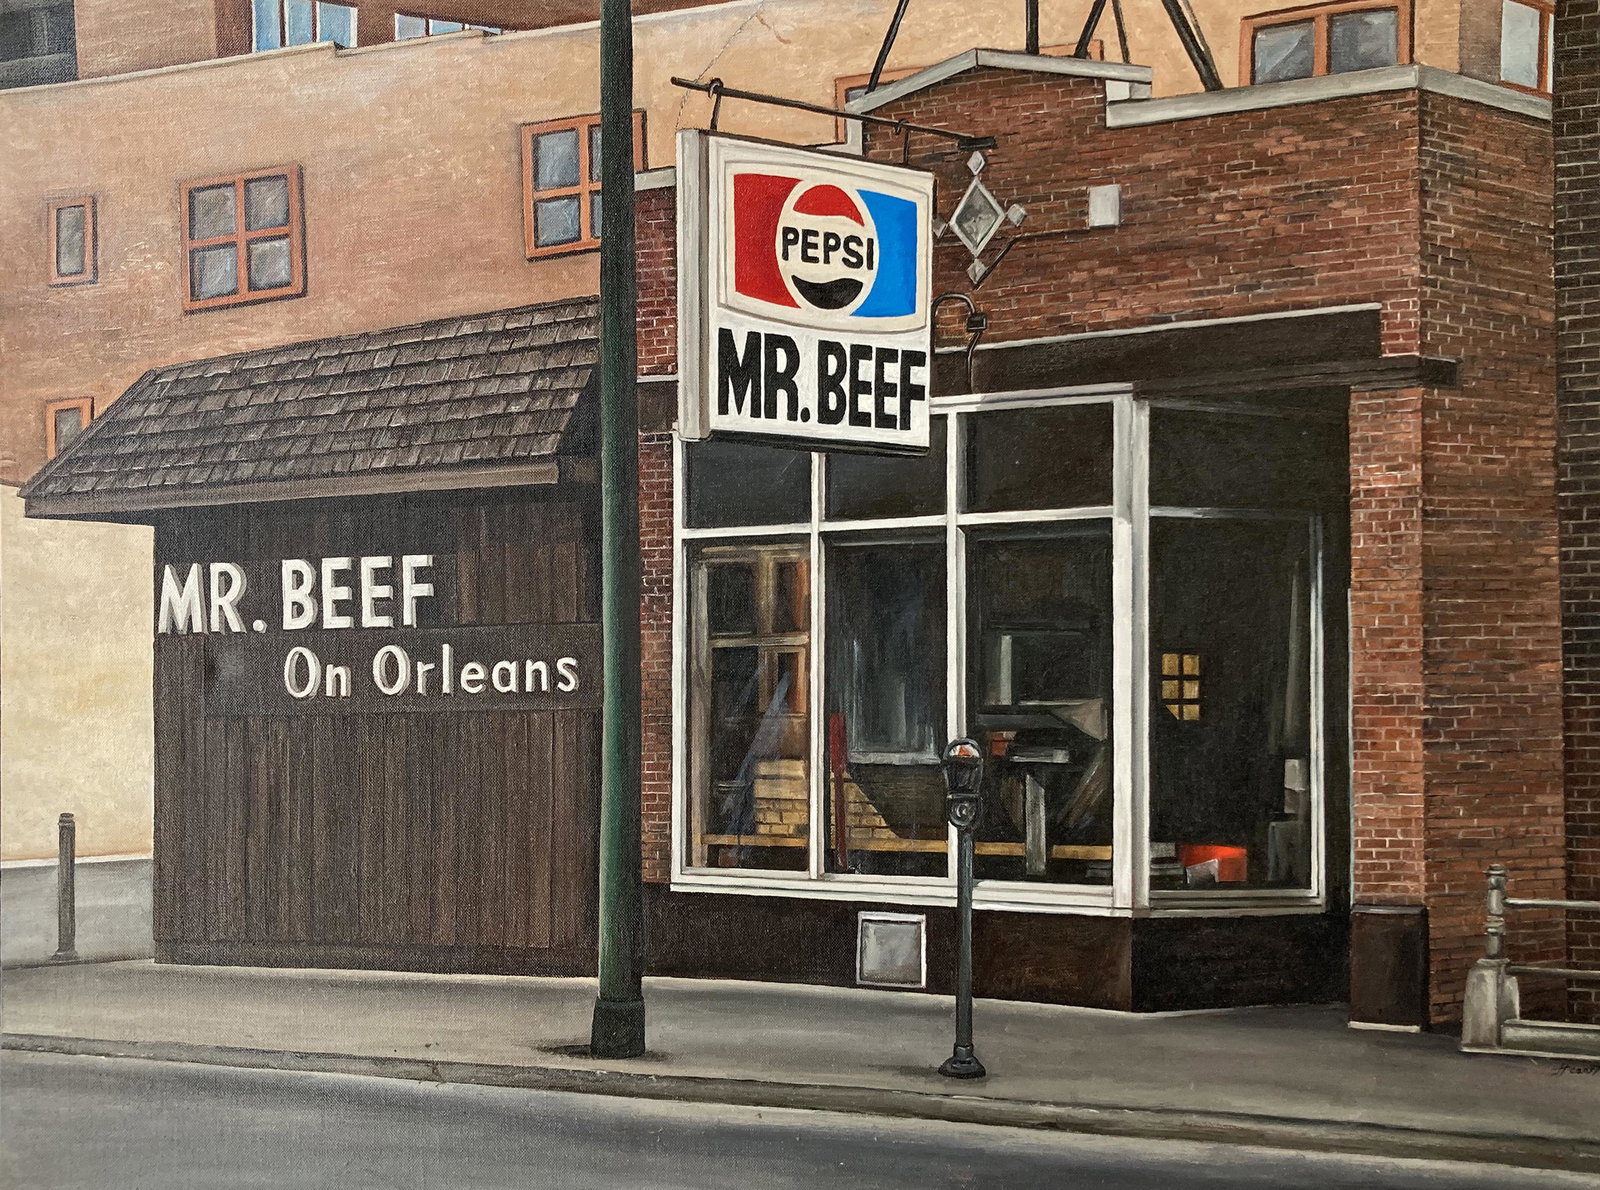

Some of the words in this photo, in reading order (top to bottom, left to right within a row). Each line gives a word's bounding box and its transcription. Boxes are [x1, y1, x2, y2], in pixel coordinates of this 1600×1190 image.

[781, 226, 874, 270] PEPSI
[718, 327, 811, 422] MR.
[817, 339, 927, 431] BEEF
[157, 562, 267, 634] MR.
[282, 554, 433, 630] BEEF
[283, 646, 351, 698] On
[372, 644, 579, 697] Orleans
